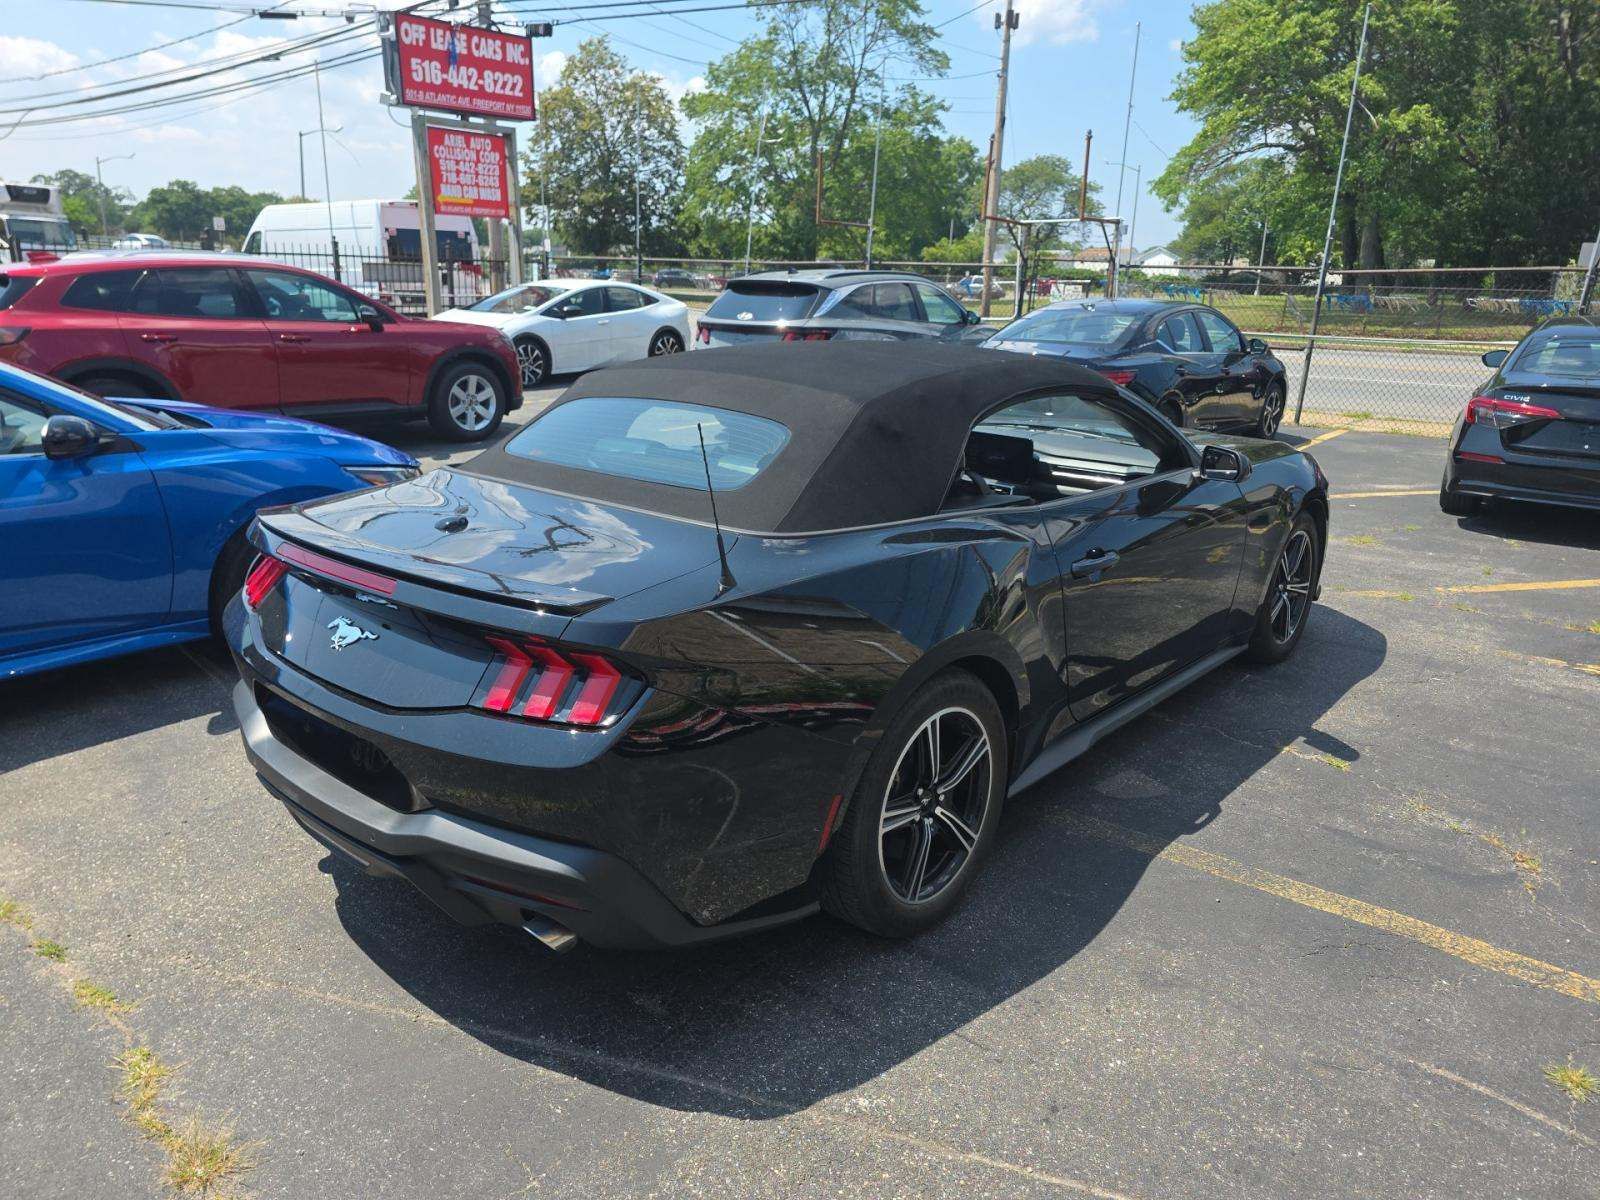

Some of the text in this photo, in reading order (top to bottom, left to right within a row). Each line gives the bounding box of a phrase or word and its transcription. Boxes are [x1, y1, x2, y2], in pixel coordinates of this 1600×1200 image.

[400, 21, 426, 46] OFF
[471, 35, 503, 61] CARS
[505, 42, 530, 66] INC.
[410, 57, 524, 97] 516-442-8222
[425, 91, 456, 104] ATLANTIC
[473, 98, 505, 110] FREEPORT
[470, 136, 492, 151] AUTO
[433, 144, 477, 162] COLLISION
[463, 185, 479, 199] CAR
[479, 187, 502, 201] WASH
